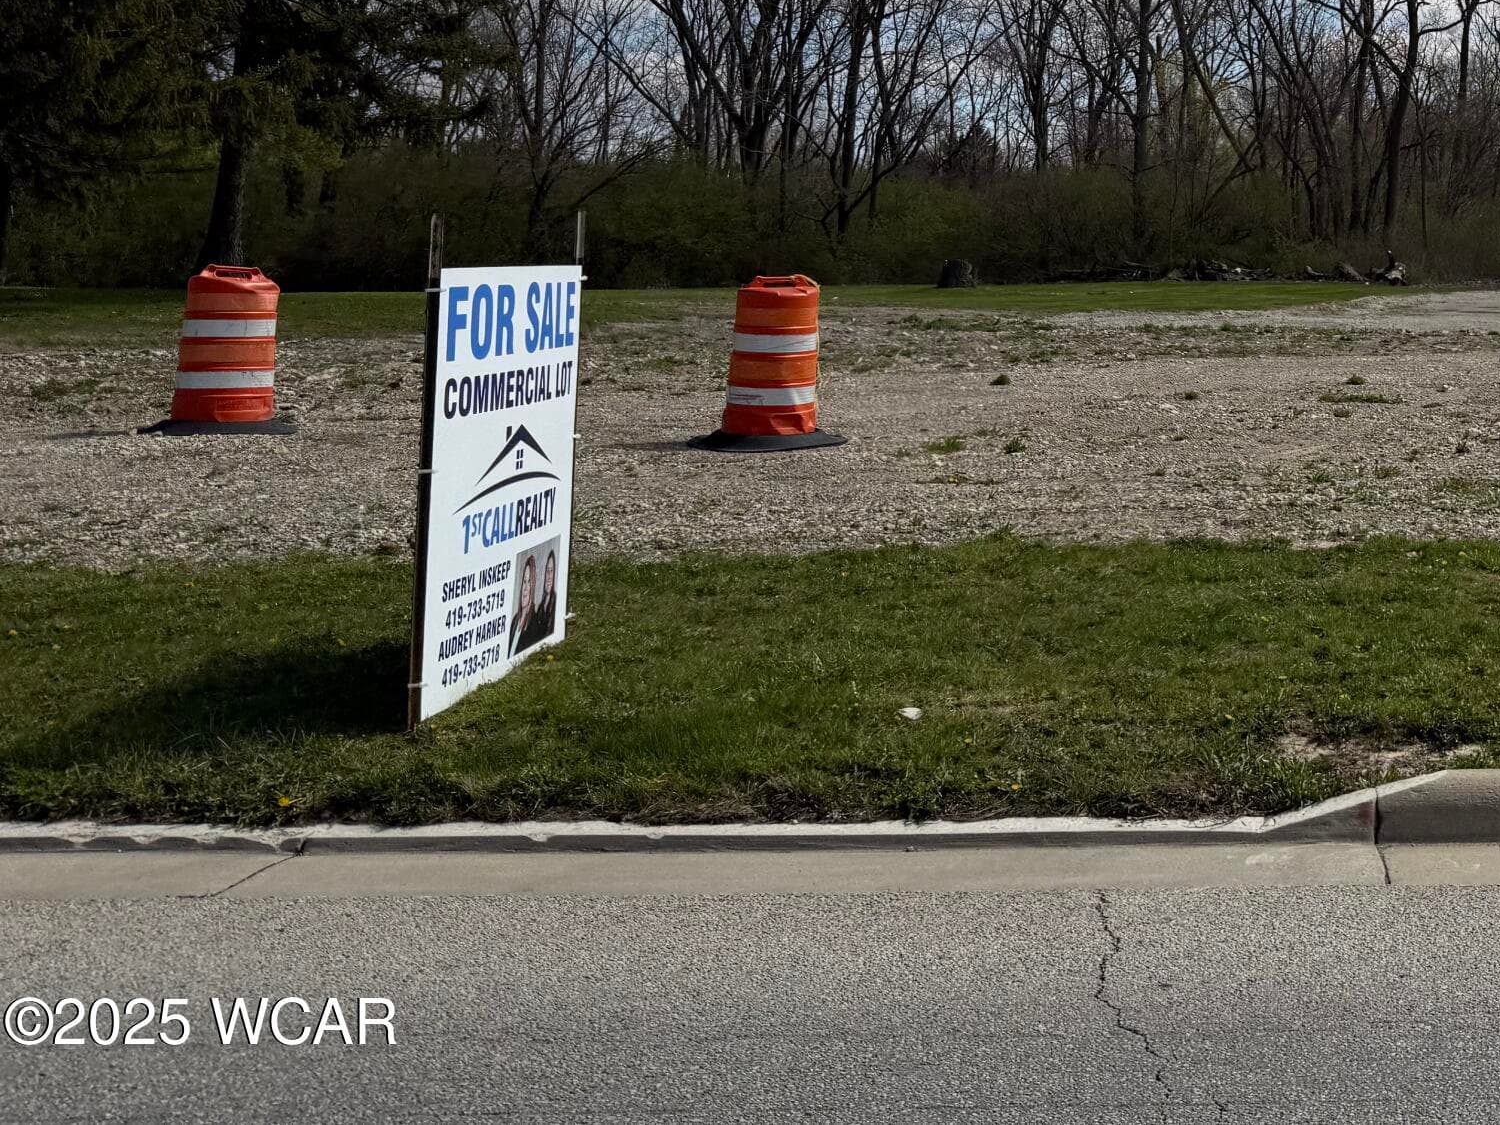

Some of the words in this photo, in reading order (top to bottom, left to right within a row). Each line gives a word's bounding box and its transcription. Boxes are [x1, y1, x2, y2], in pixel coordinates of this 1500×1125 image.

[446, 284, 515, 362] FOR
[525, 281, 576, 353] SALE
[443, 364, 551, 419] COMMERCIAL
[555, 361, 573, 397] LOT
[442, 573, 476, 603] SHERYL
[479, 560, 511, 589] INSKEEP
[445, 588, 505, 629] 419-733-5719
[438, 629, 474, 662] AUDREY
[475, 614, 506, 645] HARNER
